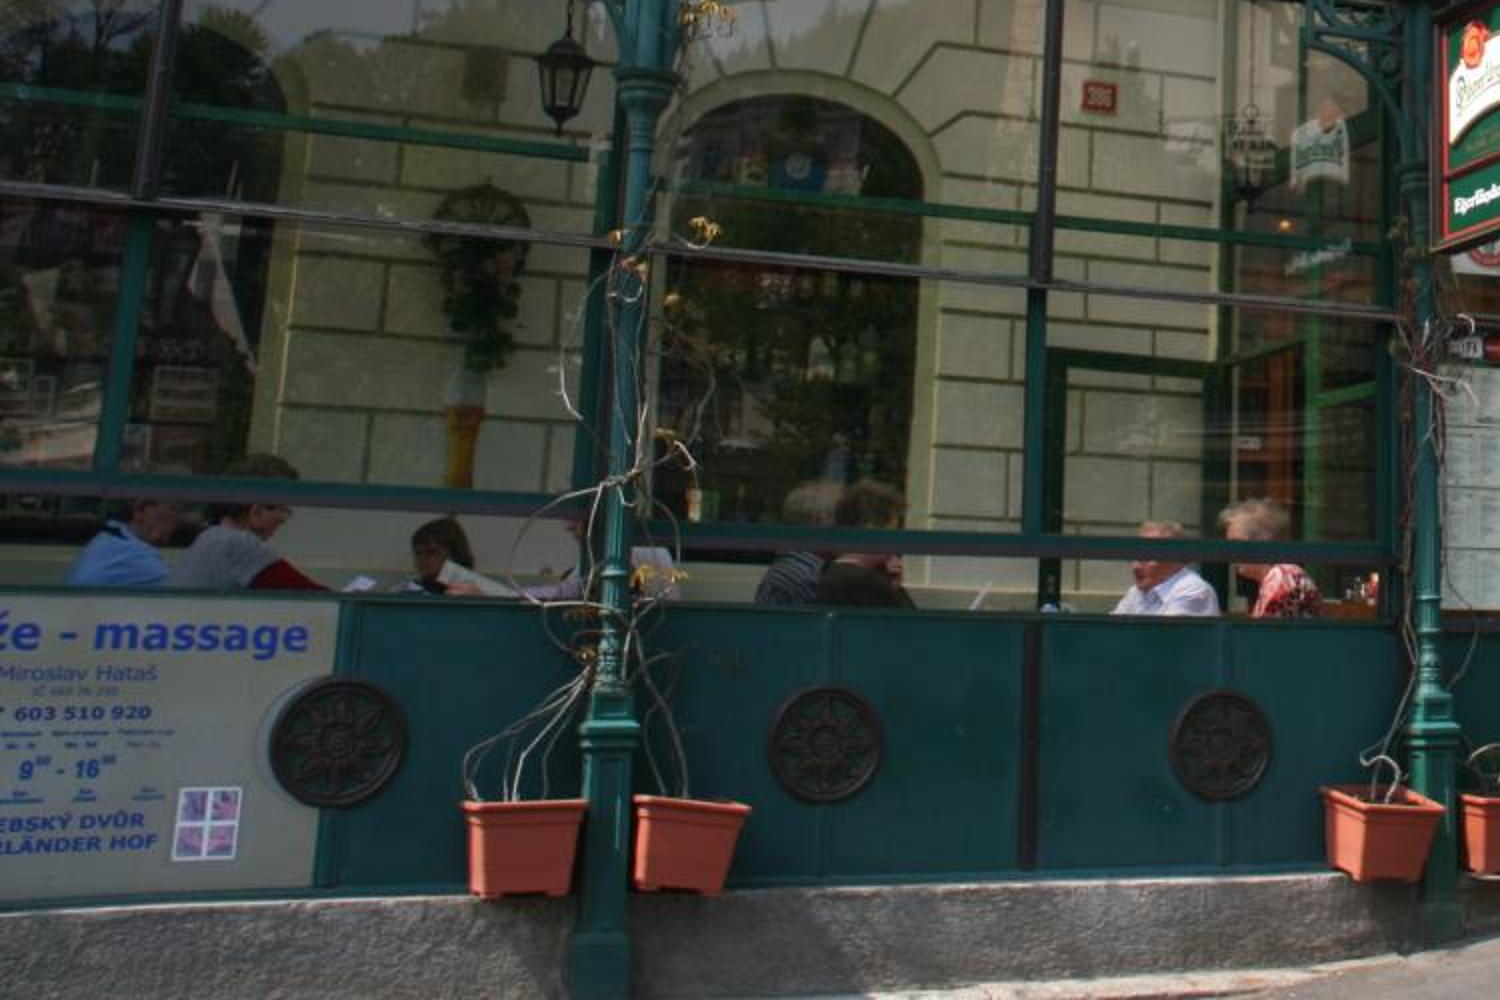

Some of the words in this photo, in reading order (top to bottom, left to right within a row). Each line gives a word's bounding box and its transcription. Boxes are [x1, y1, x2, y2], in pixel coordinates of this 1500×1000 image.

[94, 622, 309, 661] massage
[0, 665, 88, 682] Miroslav
[96, 663, 160, 682] Hataš
[14, 706, 57, 721] 603
[64, 706, 105, 721] 510
[111, 705, 153, 720] 920
[79, 809, 146, 829] DVŮR
[109, 833, 159, 851] HOF
